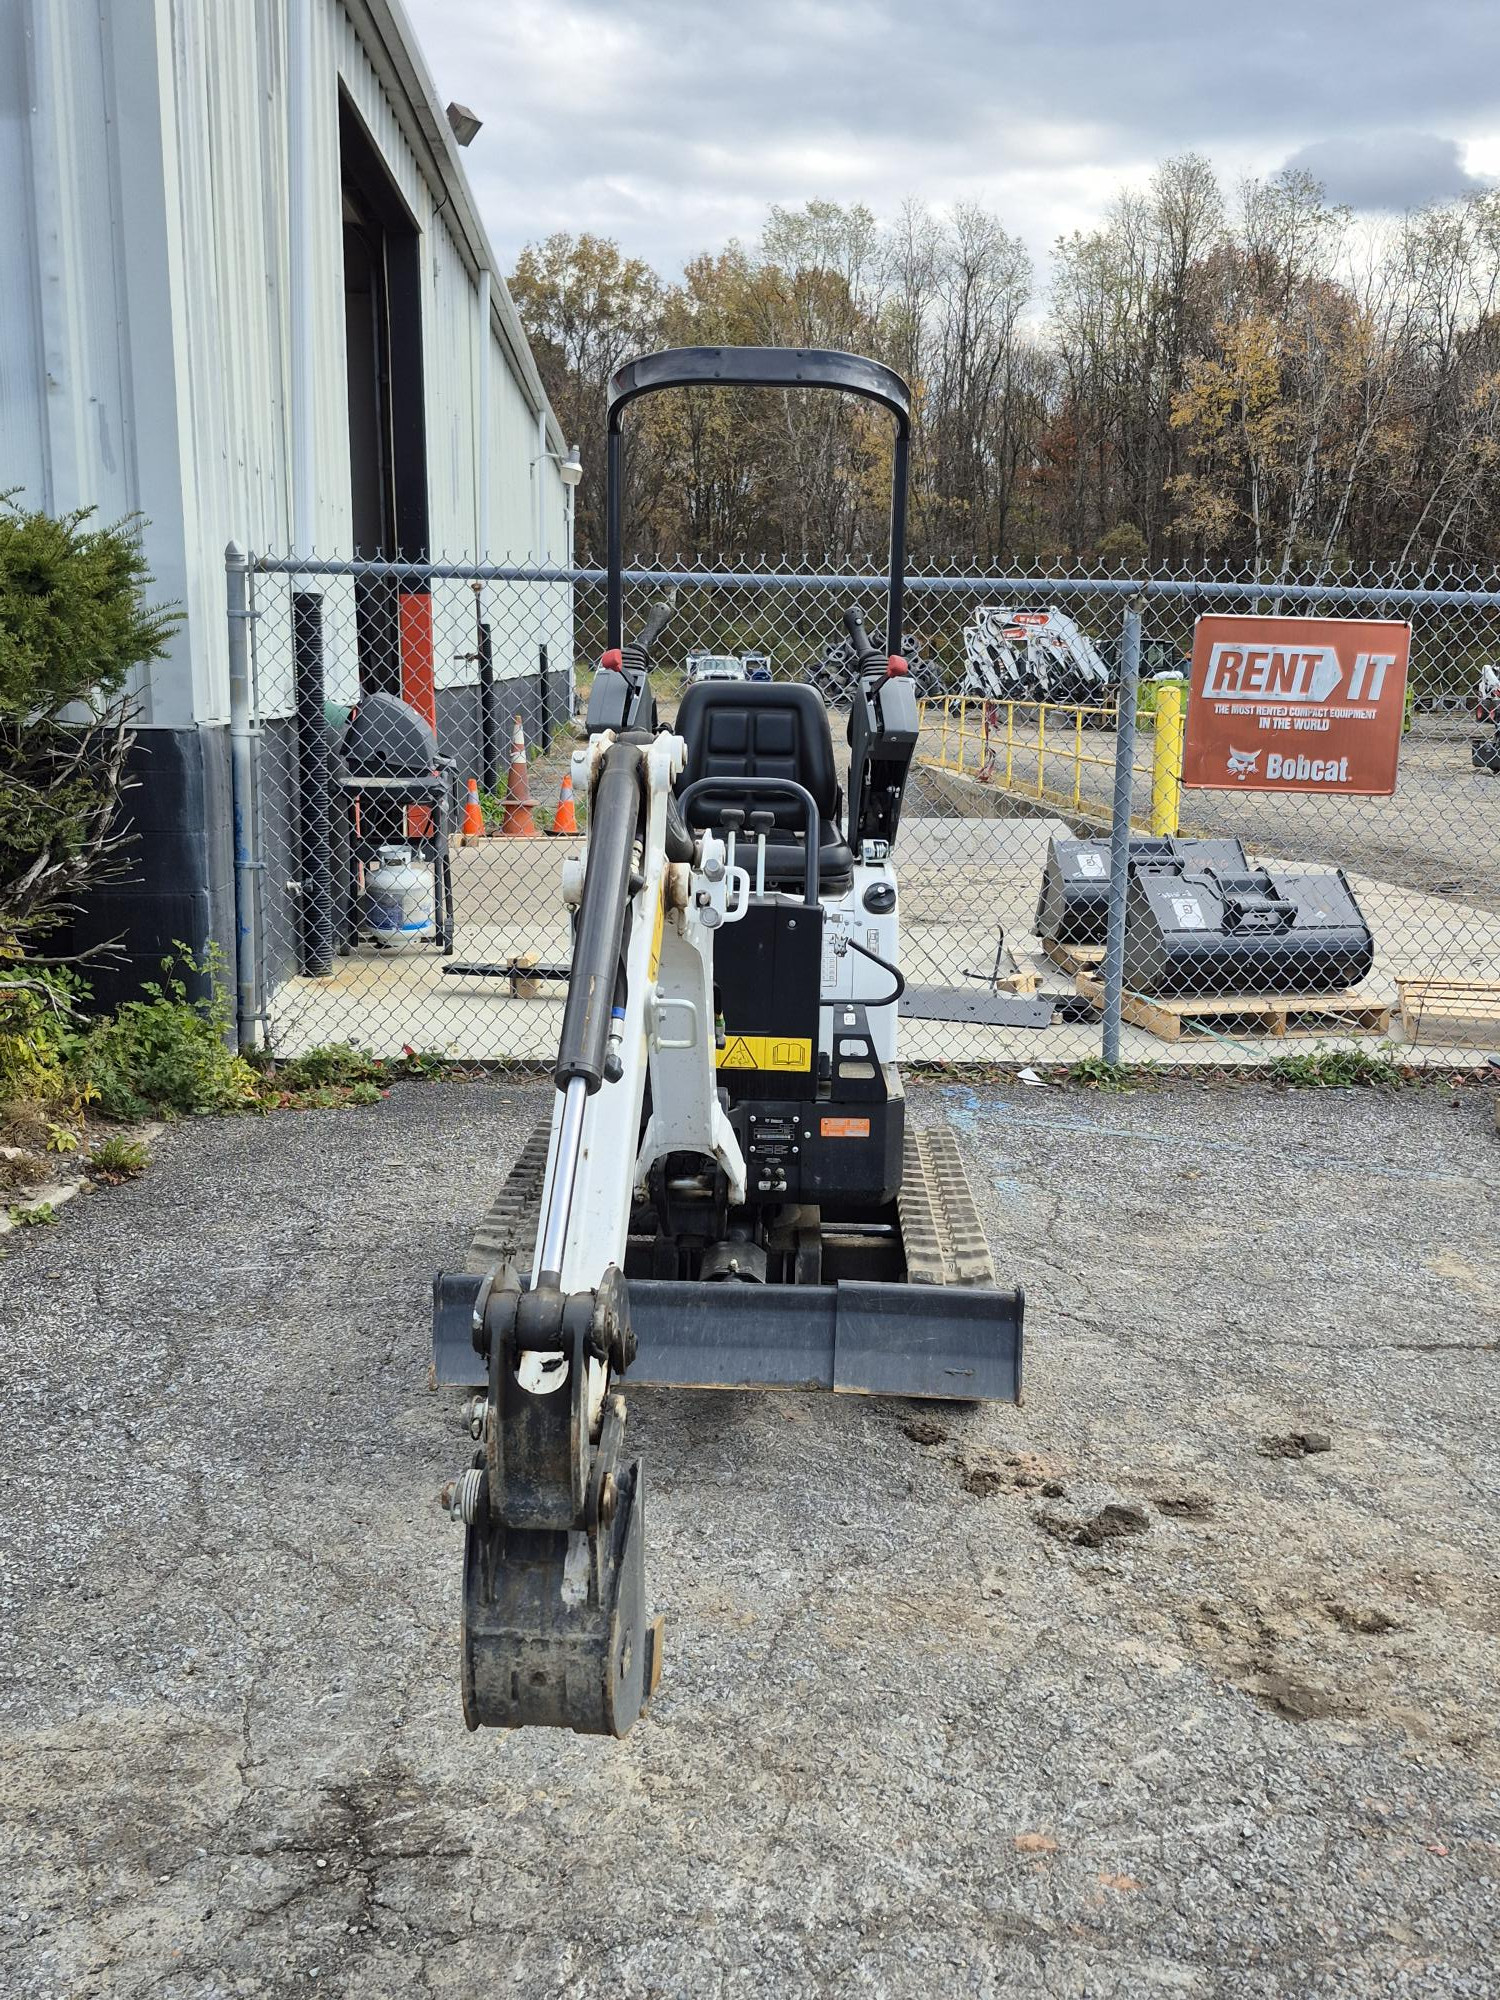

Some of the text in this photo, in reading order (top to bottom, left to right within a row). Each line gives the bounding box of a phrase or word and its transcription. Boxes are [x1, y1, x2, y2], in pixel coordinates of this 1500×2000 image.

[1212, 651, 1396, 700] RENT IT
[1214, 703, 1377, 720] THE MOST RENTED COMPACT EQUIPMENT
[1258, 717, 1330, 731] IN THE WORLD
[1266, 753, 1348, 782] Bobcat
